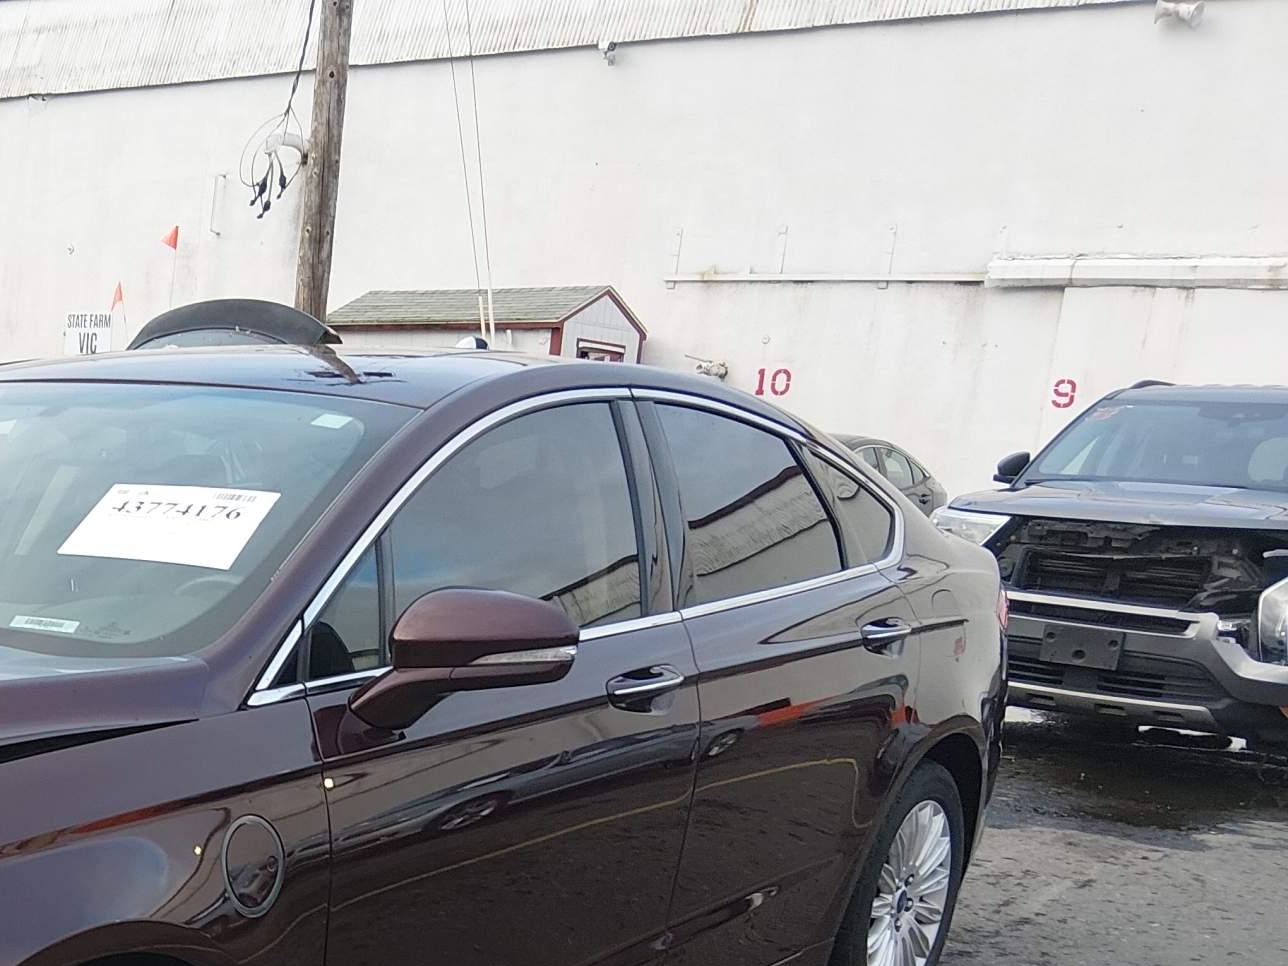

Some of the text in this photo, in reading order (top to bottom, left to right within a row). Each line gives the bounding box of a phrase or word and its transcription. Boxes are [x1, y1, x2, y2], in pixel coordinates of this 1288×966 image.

[67, 313, 111, 328] STATE FARM
[79, 332, 98, 354] VIC
[755, 368, 792, 396] 10
[1051, 378, 1077, 409] 9
[112, 500, 242, 520] 43774176
